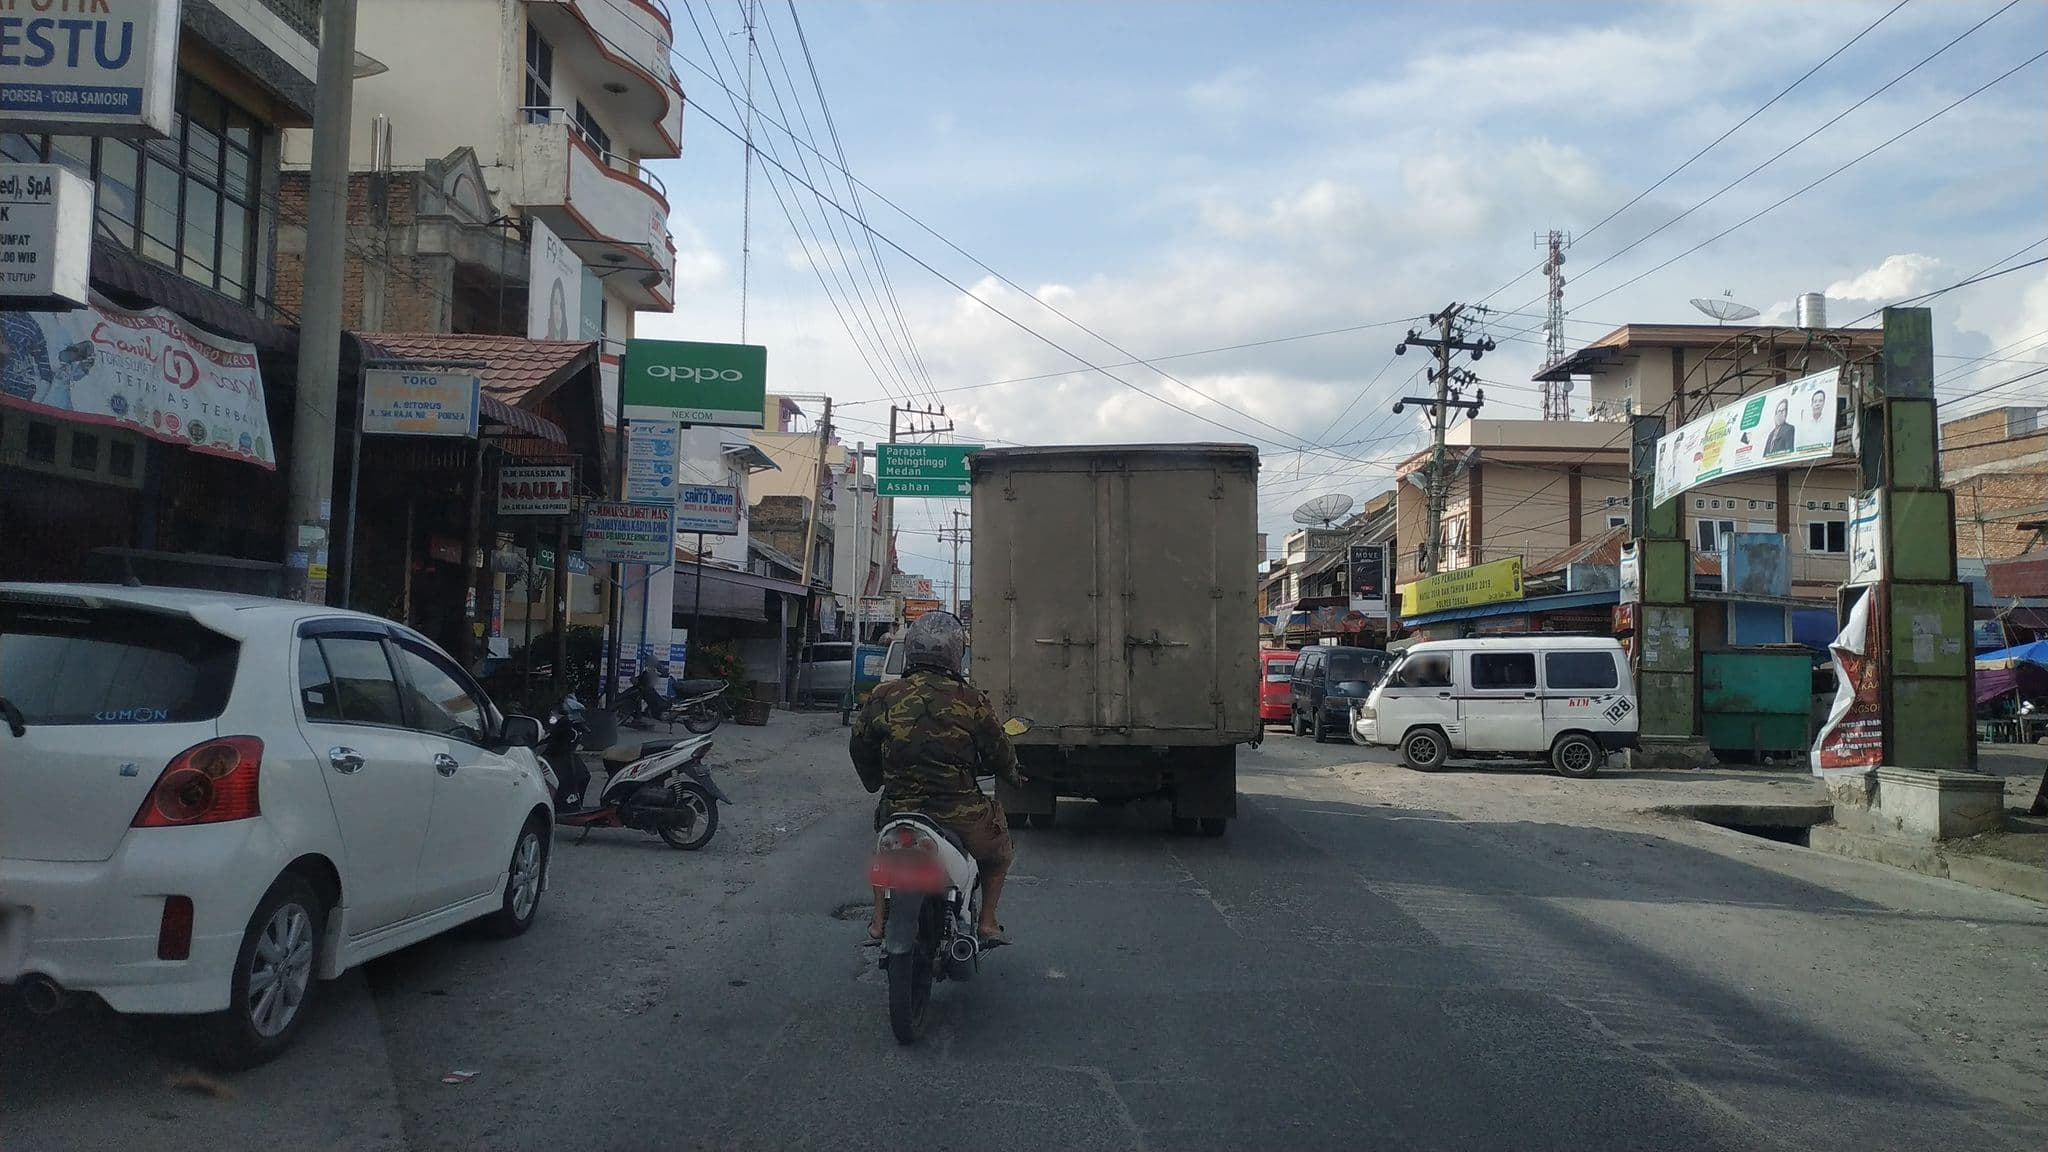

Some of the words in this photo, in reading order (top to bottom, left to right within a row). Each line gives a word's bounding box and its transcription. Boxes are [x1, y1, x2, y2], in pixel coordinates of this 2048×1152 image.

[2, 89, 43, 103] PORSEA
[51, 90, 79, 104] TOBA
[80, 92, 129, 105] SAMOSIR
[26, 176, 52, 200] SpA
[17, 252, 37, 264] WIB
[7, 272, 36, 283] TUTUP
[401, 376, 438, 386] TOKO
[886, 447, 927, 456] Parapat
[886, 456, 947, 468] Tebingtinggi
[886, 466, 921, 476] Medan
[886, 482, 930, 492] Asahan
[1606, 699, 1631, 722] 128
